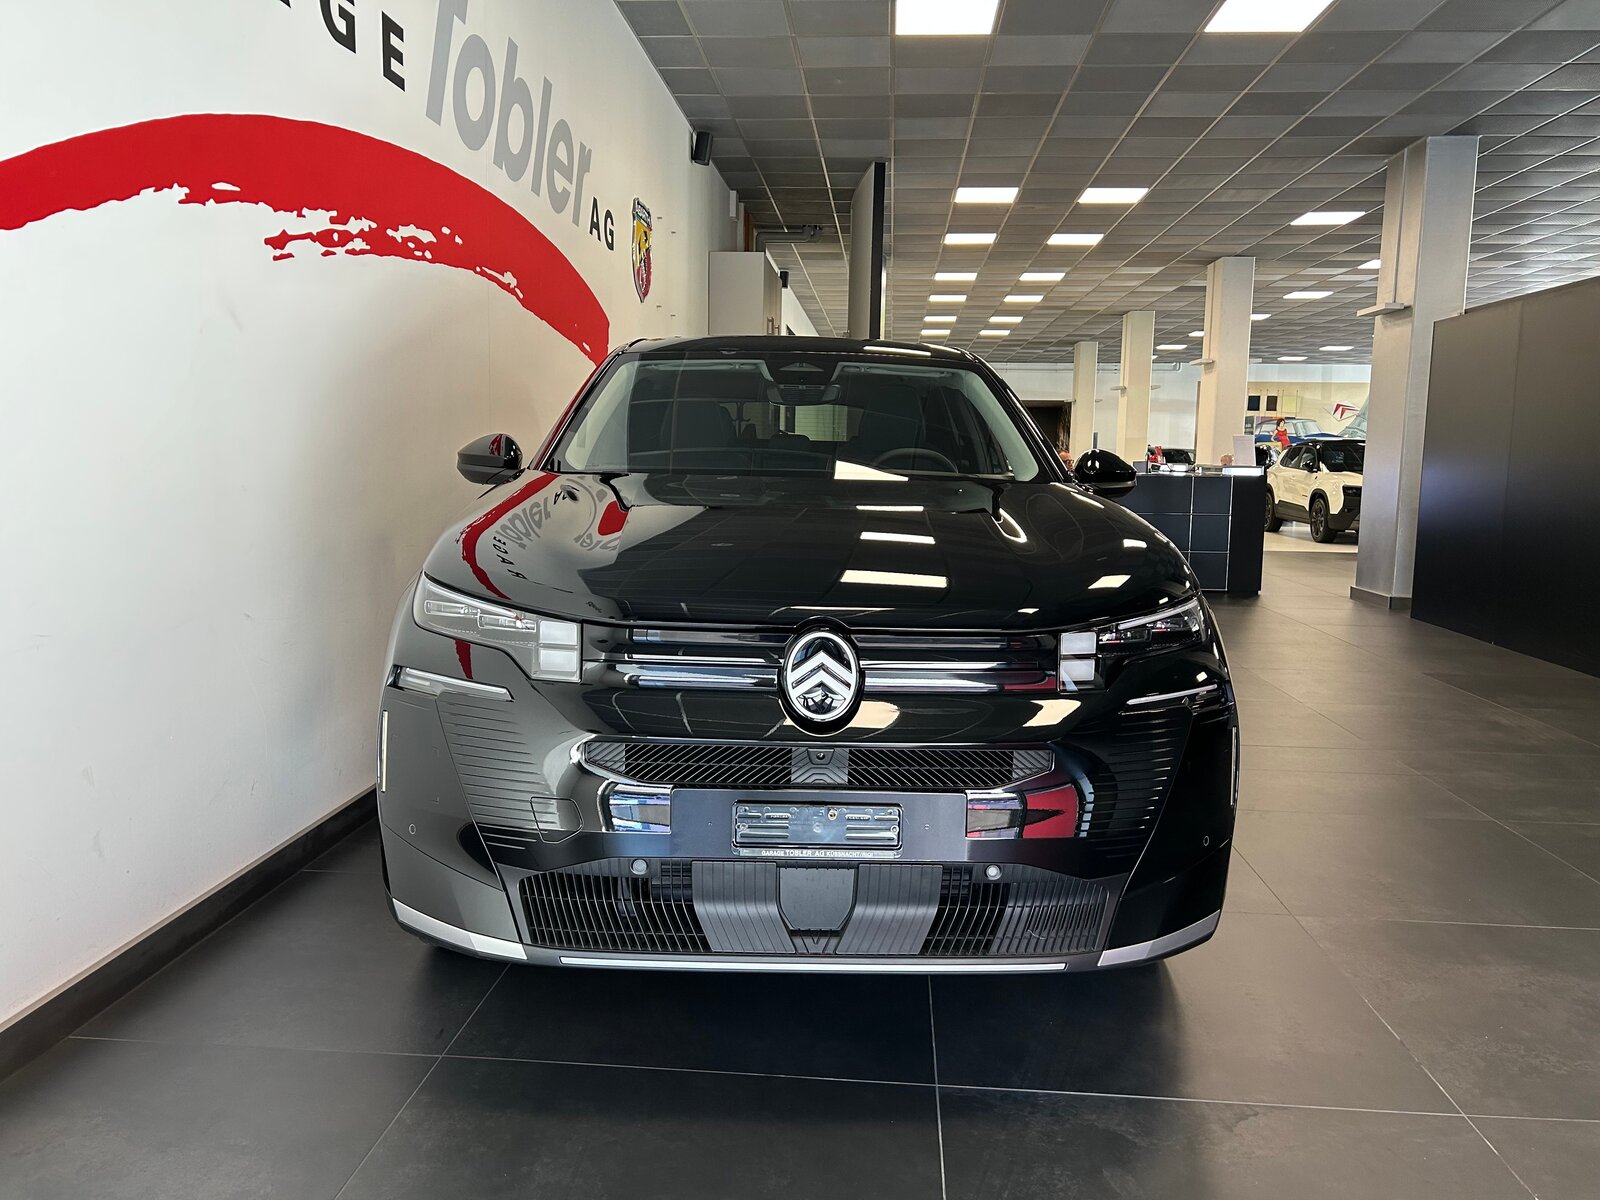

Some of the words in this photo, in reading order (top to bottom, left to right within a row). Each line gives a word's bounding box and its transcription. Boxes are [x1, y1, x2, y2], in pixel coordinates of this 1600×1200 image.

[279, 0, 405, 92] GE
[425, 0, 592, 226] Tobler
[589, 196, 615, 251] AG
[785, 849, 812, 857] TOBLER
